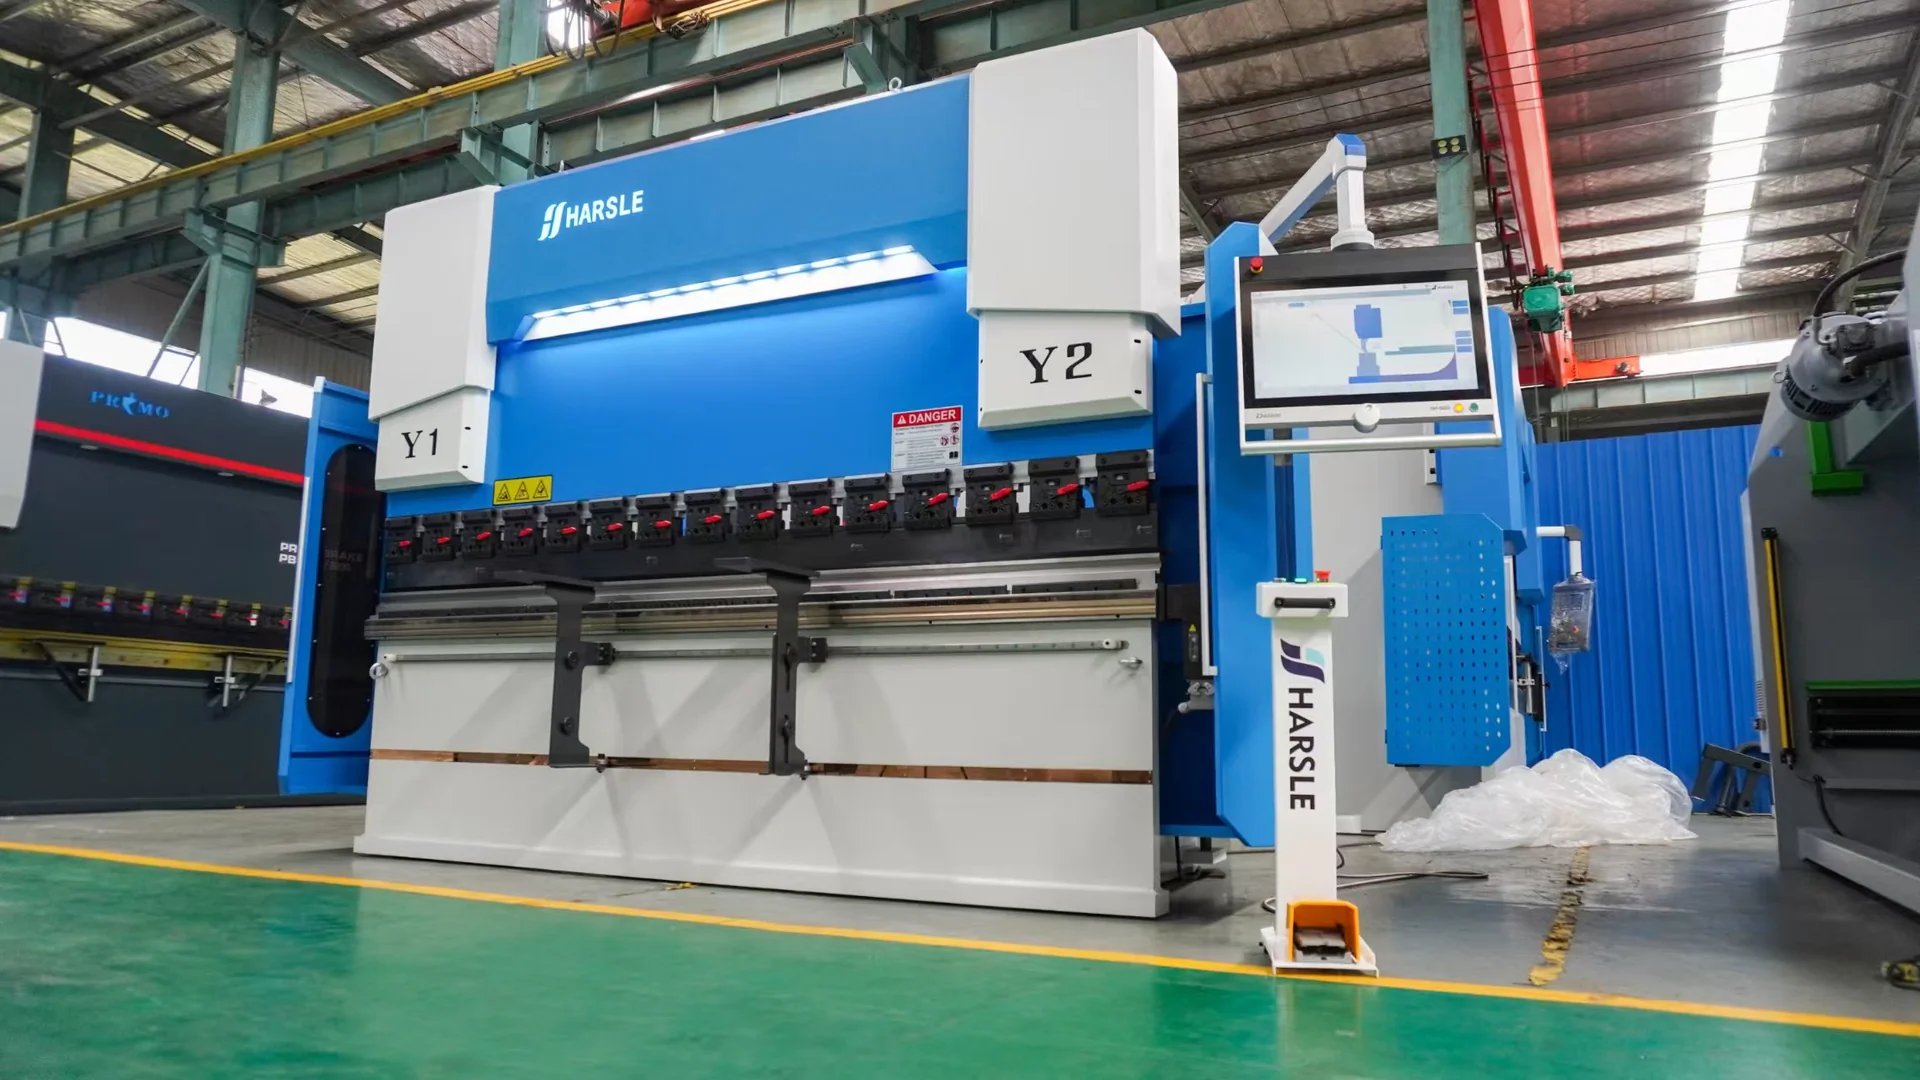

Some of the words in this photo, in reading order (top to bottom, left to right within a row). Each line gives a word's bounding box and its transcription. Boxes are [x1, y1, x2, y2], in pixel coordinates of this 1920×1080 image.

[565, 189, 644, 228] HARSLE
[1019, 341, 1092, 384] Y2
[908, 409, 957, 424] DANGER
[401, 428, 438, 459] Y1
[1288, 687, 1316, 810] HARSLE
